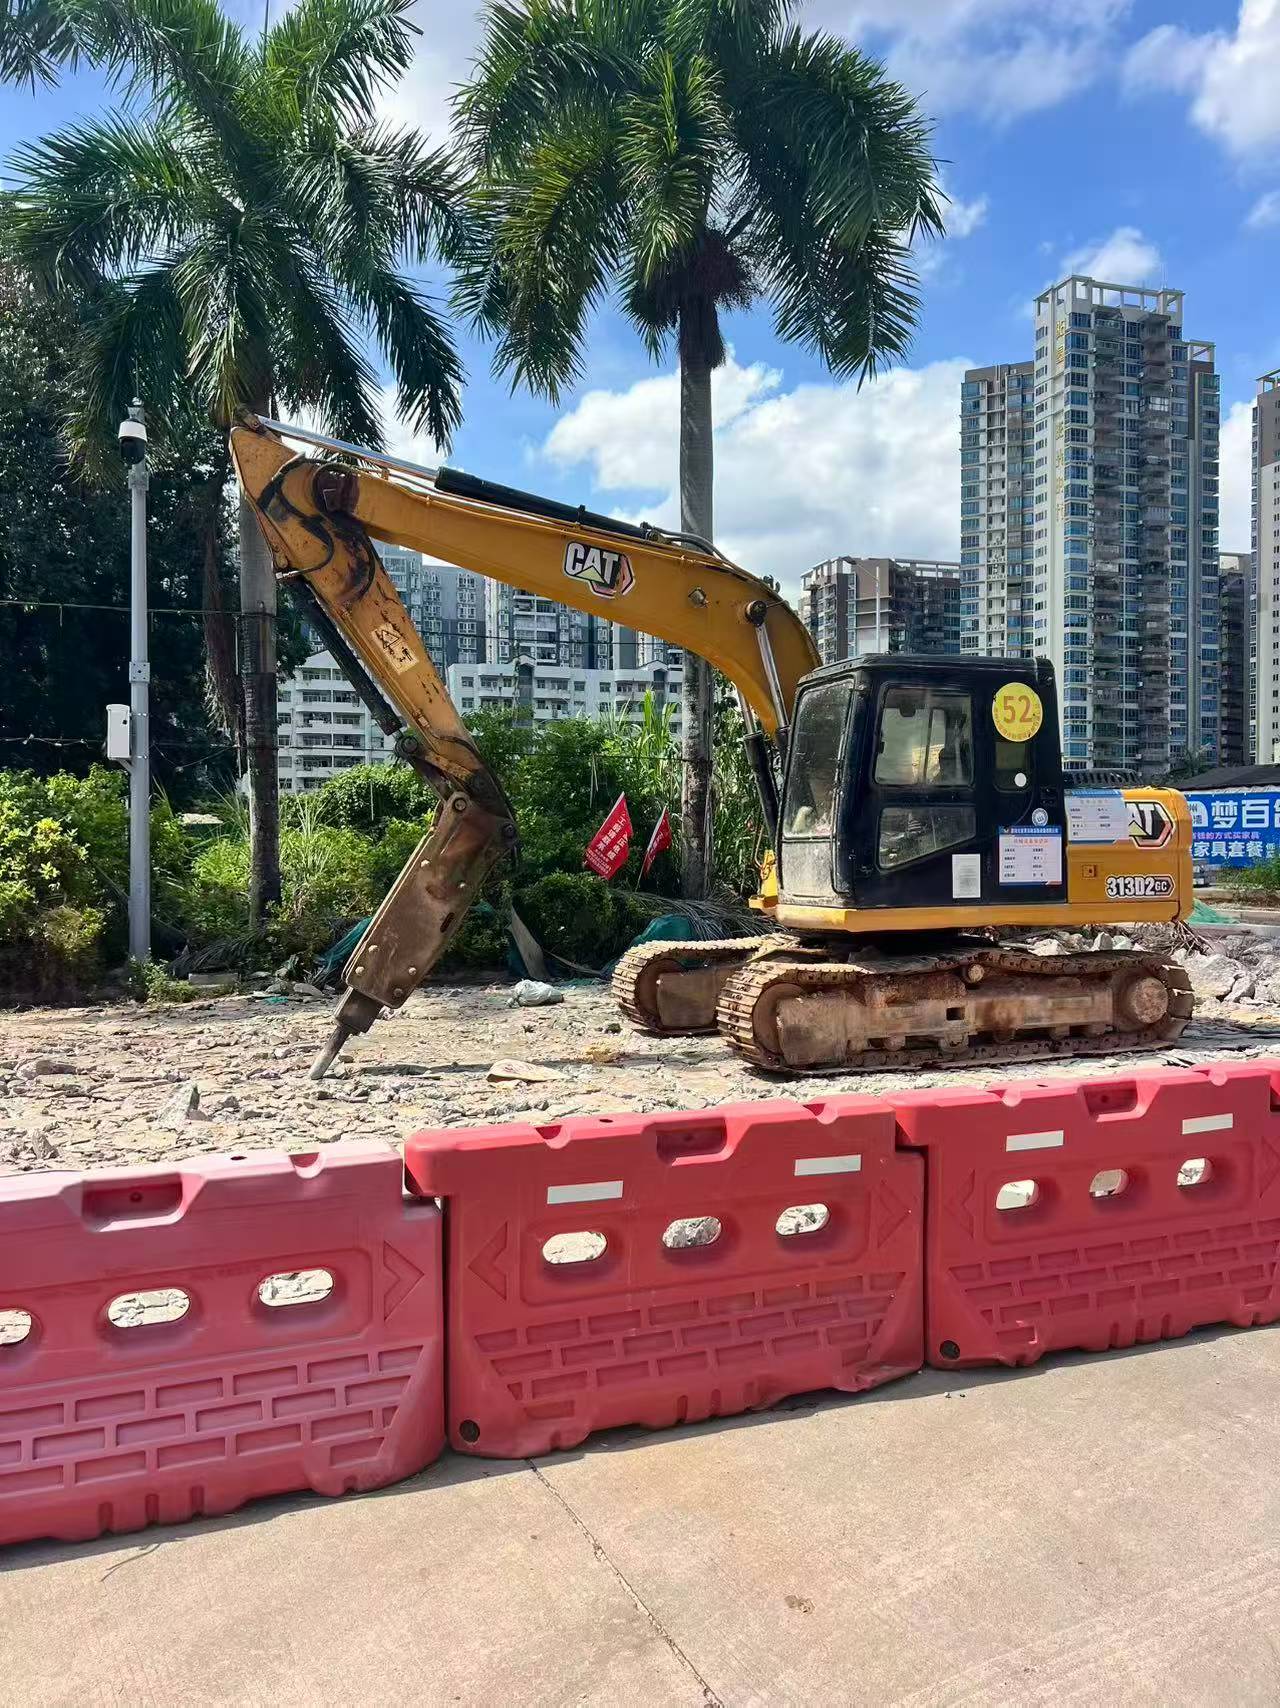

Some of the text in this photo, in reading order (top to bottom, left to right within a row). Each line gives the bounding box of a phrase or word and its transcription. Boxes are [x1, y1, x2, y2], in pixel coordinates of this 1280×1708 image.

[565, 542, 620, 585] CAT
[1003, 695, 1033, 724] 52
[1189, 841, 1264, 858] 家具套餐
[1106, 876, 1168, 896] 313D2 GC
